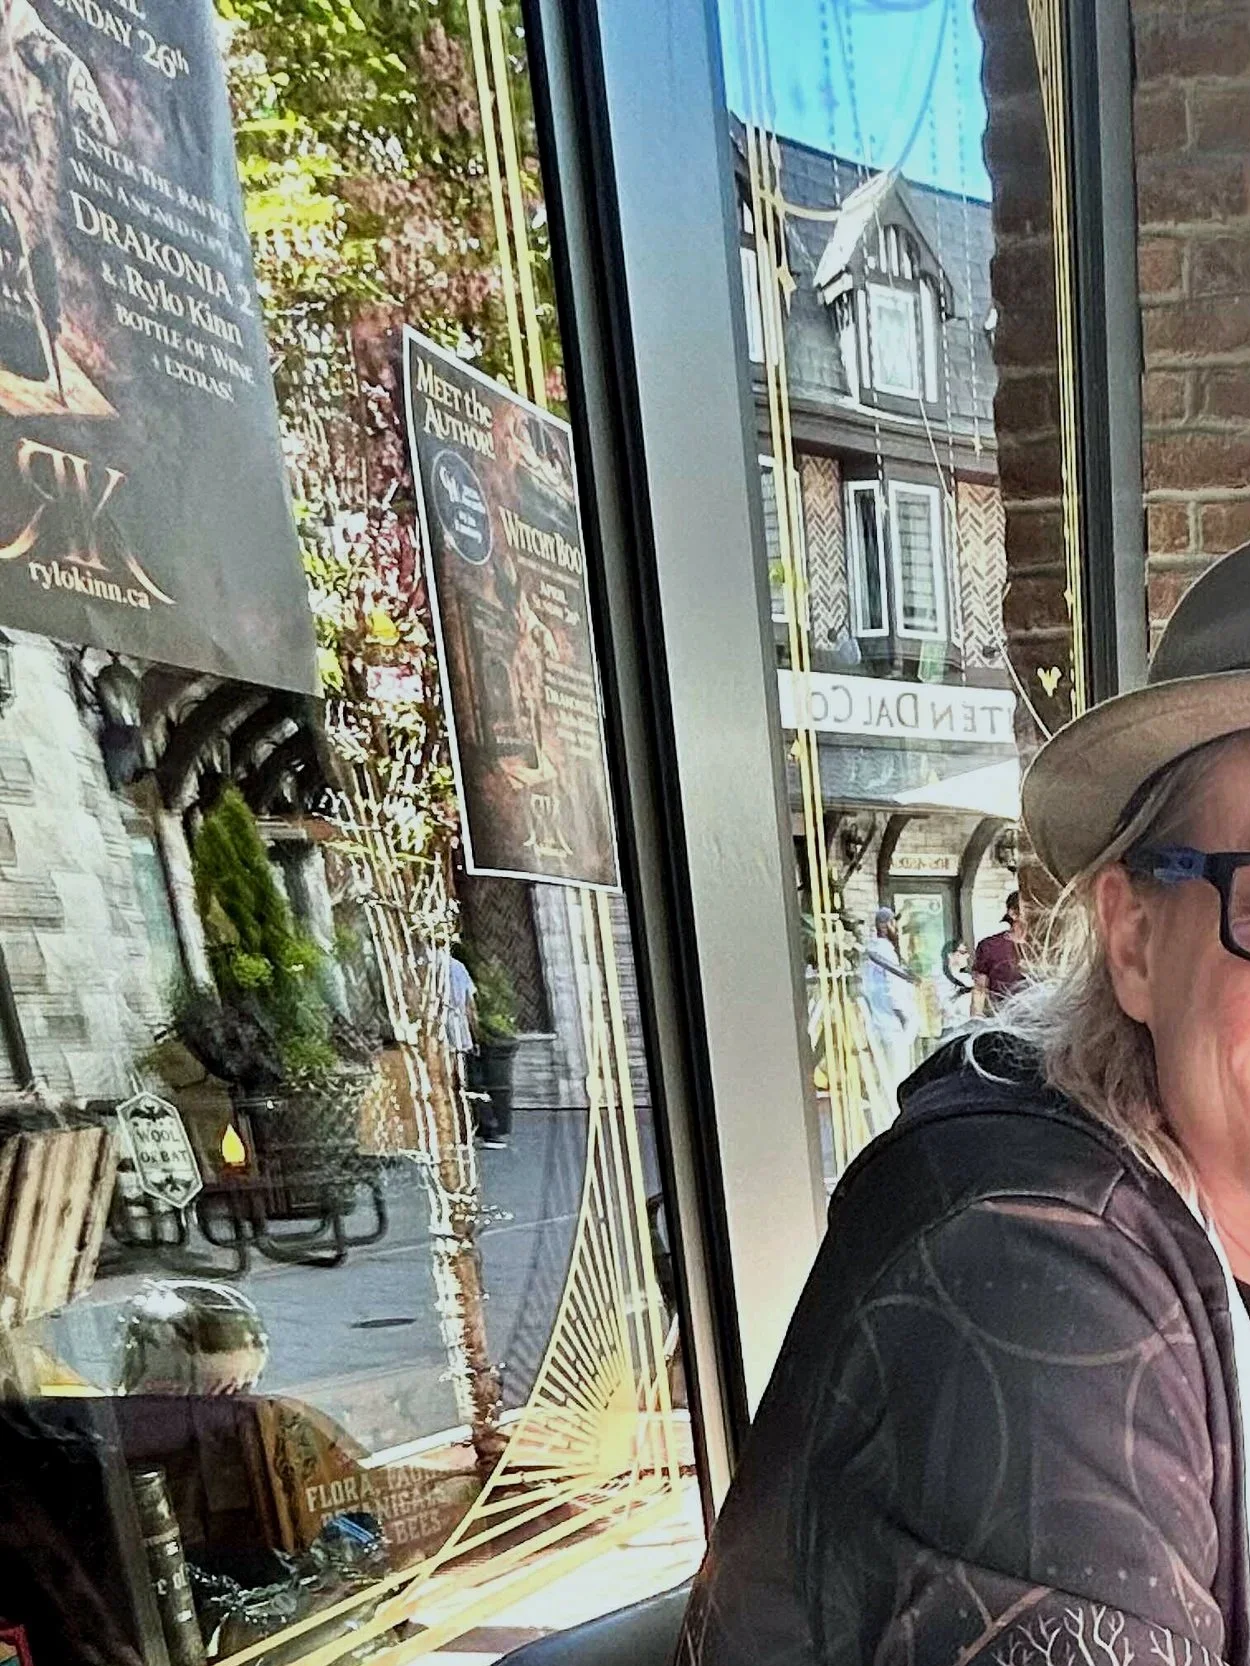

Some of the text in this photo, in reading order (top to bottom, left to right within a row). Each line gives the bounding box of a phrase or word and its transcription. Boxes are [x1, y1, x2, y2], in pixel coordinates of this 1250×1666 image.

[138, 29, 190, 79] 26th
[68, 157, 114, 200] WIN
[72, 126, 138, 181] ENTER
[138, 165, 175, 200] THE
[69, 190, 234, 306] DRAKONIA
[236, 284, 255, 317] 2
[124, 264, 185, 317] Rylo
[187, 295, 244, 349] Kinn
[115, 303, 255, 385] BOTTLE OF WINE
[416, 356, 494, 428] MEET the
[423, 399, 497, 461] AUTHOR!
[28, 558, 152, 610] rylokinn.ca
[136, 1129, 181, 1143] WOOL
[160, 1150, 187, 1163] BAT
